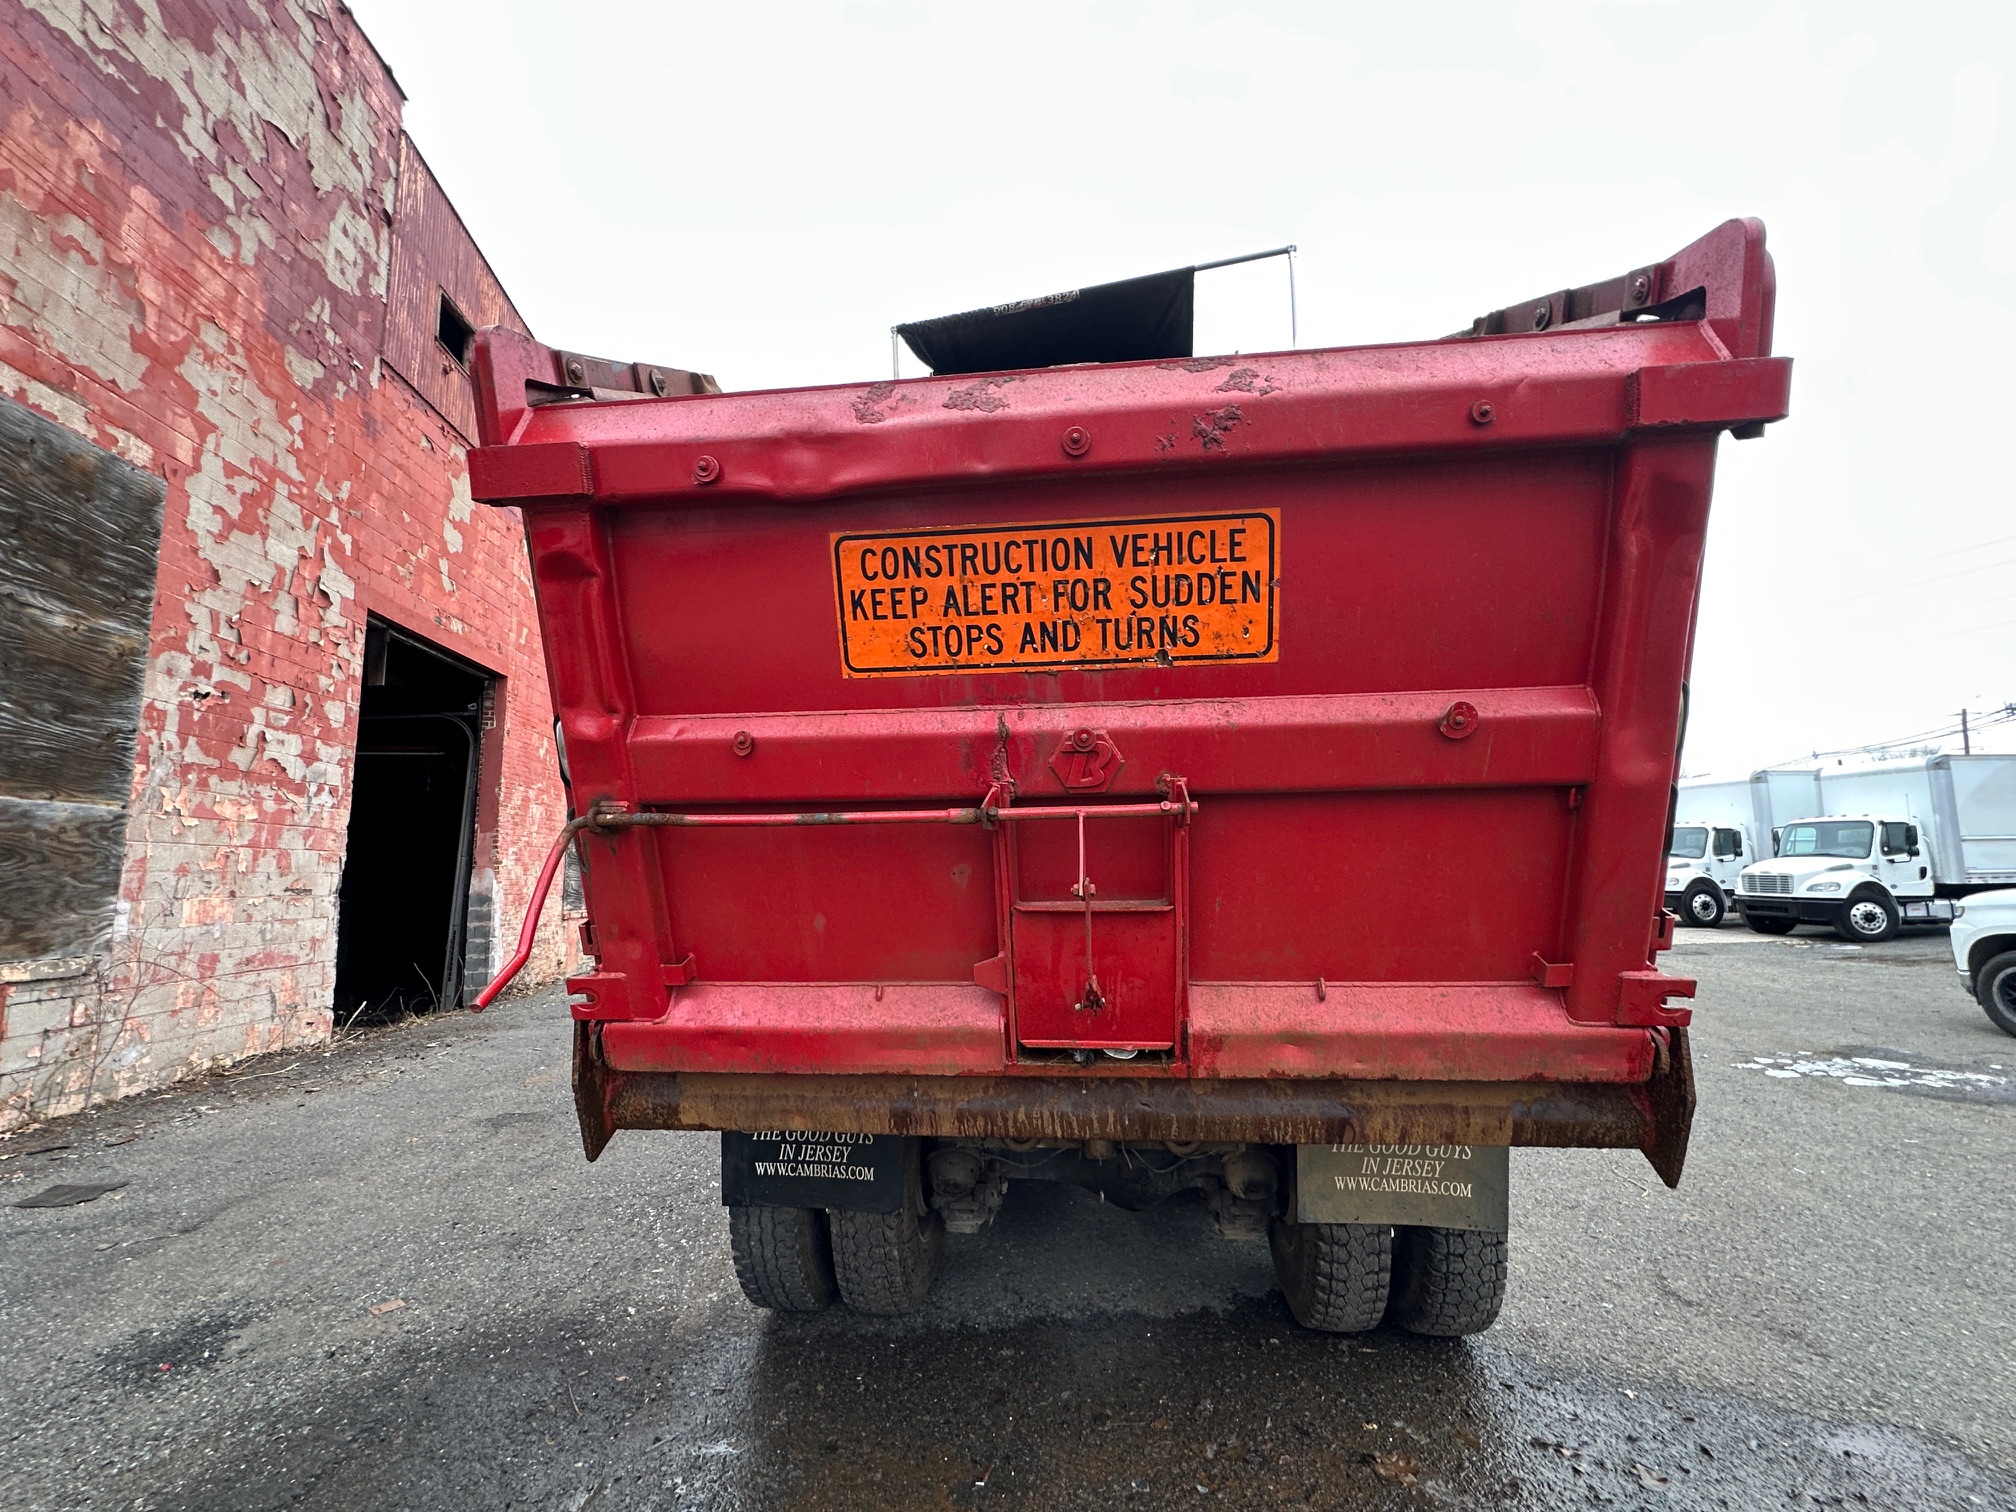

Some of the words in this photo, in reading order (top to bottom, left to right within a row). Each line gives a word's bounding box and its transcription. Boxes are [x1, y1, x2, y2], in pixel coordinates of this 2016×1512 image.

[860, 536, 1093, 581] CONSTRUCTION
[1110, 528, 1247, 569] VEHICLE
[850, 586, 929, 621] KEEP
[943, 581, 1045, 617] ALERT
[1053, 577, 1112, 613] FOR
[1130, 570, 1261, 609] SUDDEN
[910, 623, 1003, 658] STOPS
[1019, 619, 1081, 654] AND
[1096, 614, 1200, 651] TURNS
[785, 1130, 831, 1142] GOOD
[834, 1132, 874, 1145] GUYS
[779, 1143, 797, 1160] IN
[798, 1144, 852, 1163] JERSEY
[1425, 1145, 1473, 1160] GUYS
[755, 1162, 875, 1181] WWW.CAMBRIAS.COM
[1361, 1157, 1381, 1174] IN
[1383, 1158, 1445, 1178] JERSEY
[1334, 1176, 1473, 1198] WWW.CAMBRIAS.COM
